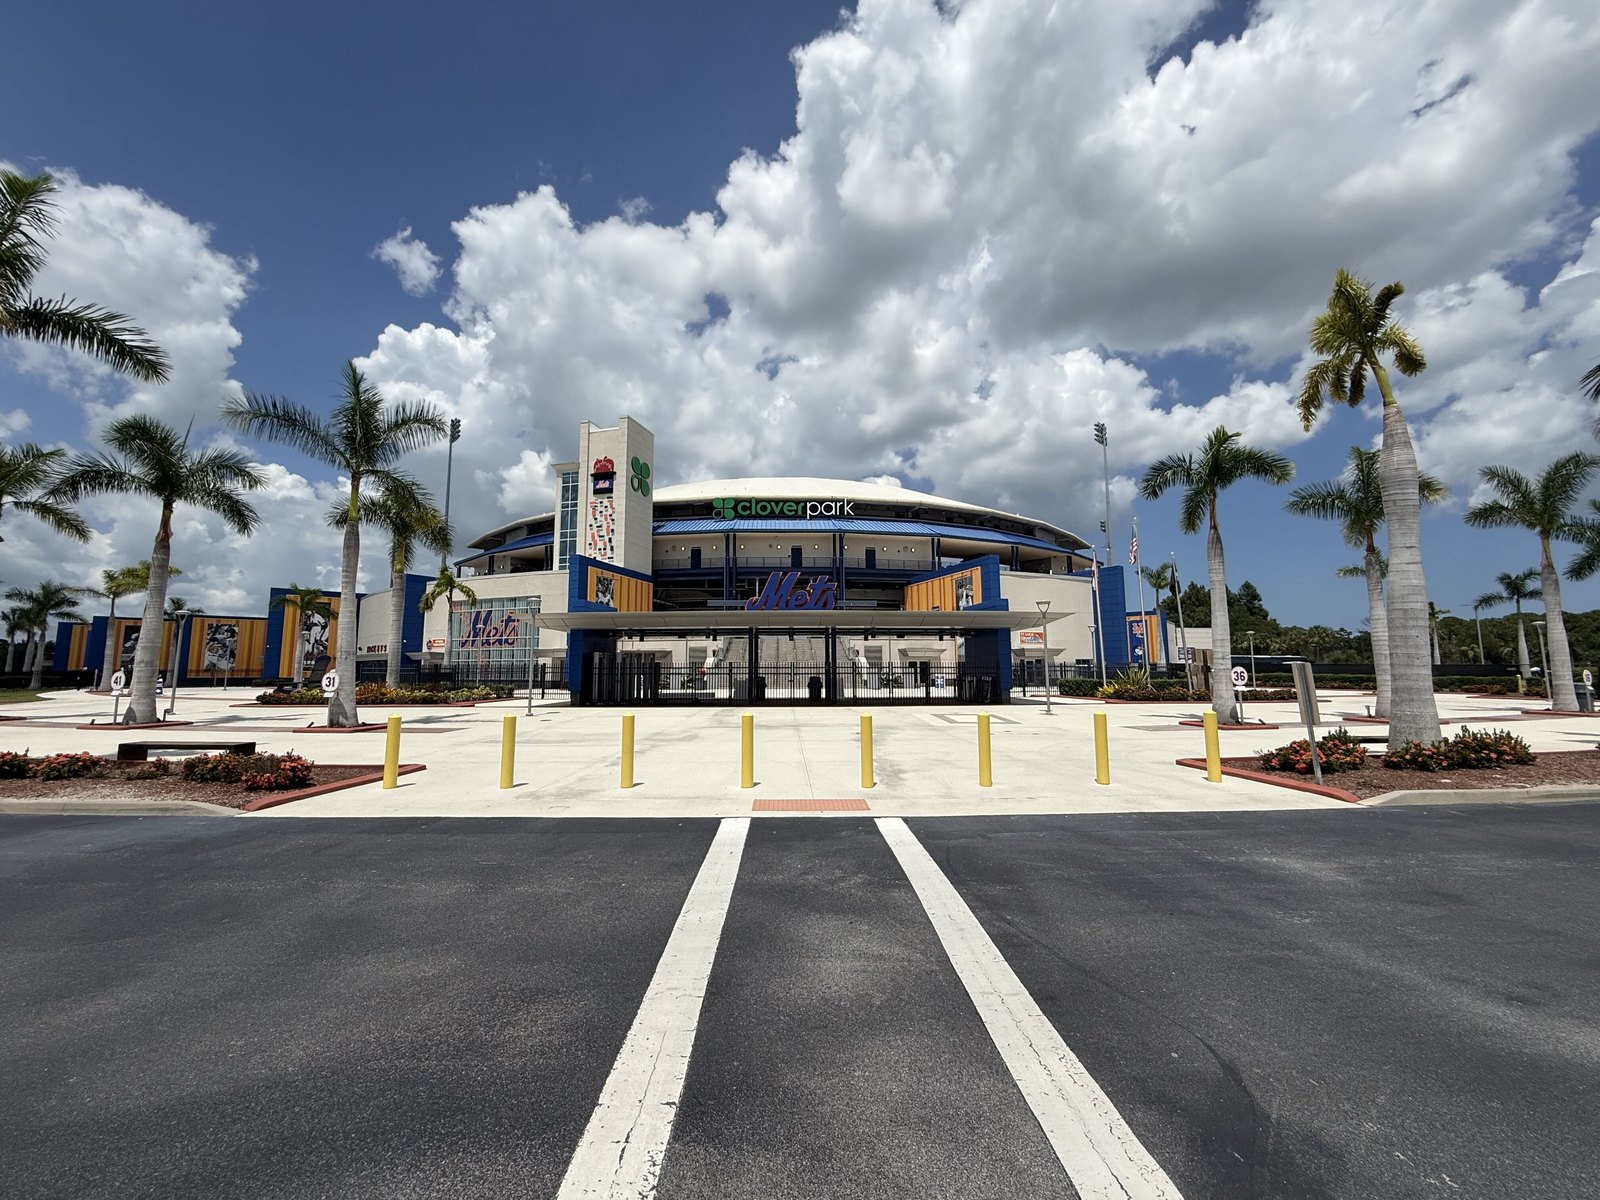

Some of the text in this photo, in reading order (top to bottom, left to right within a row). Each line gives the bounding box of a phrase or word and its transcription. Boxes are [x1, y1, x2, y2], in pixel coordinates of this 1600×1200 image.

[737, 497, 855, 519] clover park
[745, 571, 838, 610] Mets
[459, 609, 520, 648] Mets
[113, 675, 122, 686] 41
[325, 676, 335, 687] 31
[1233, 671, 1245, 681] 36
